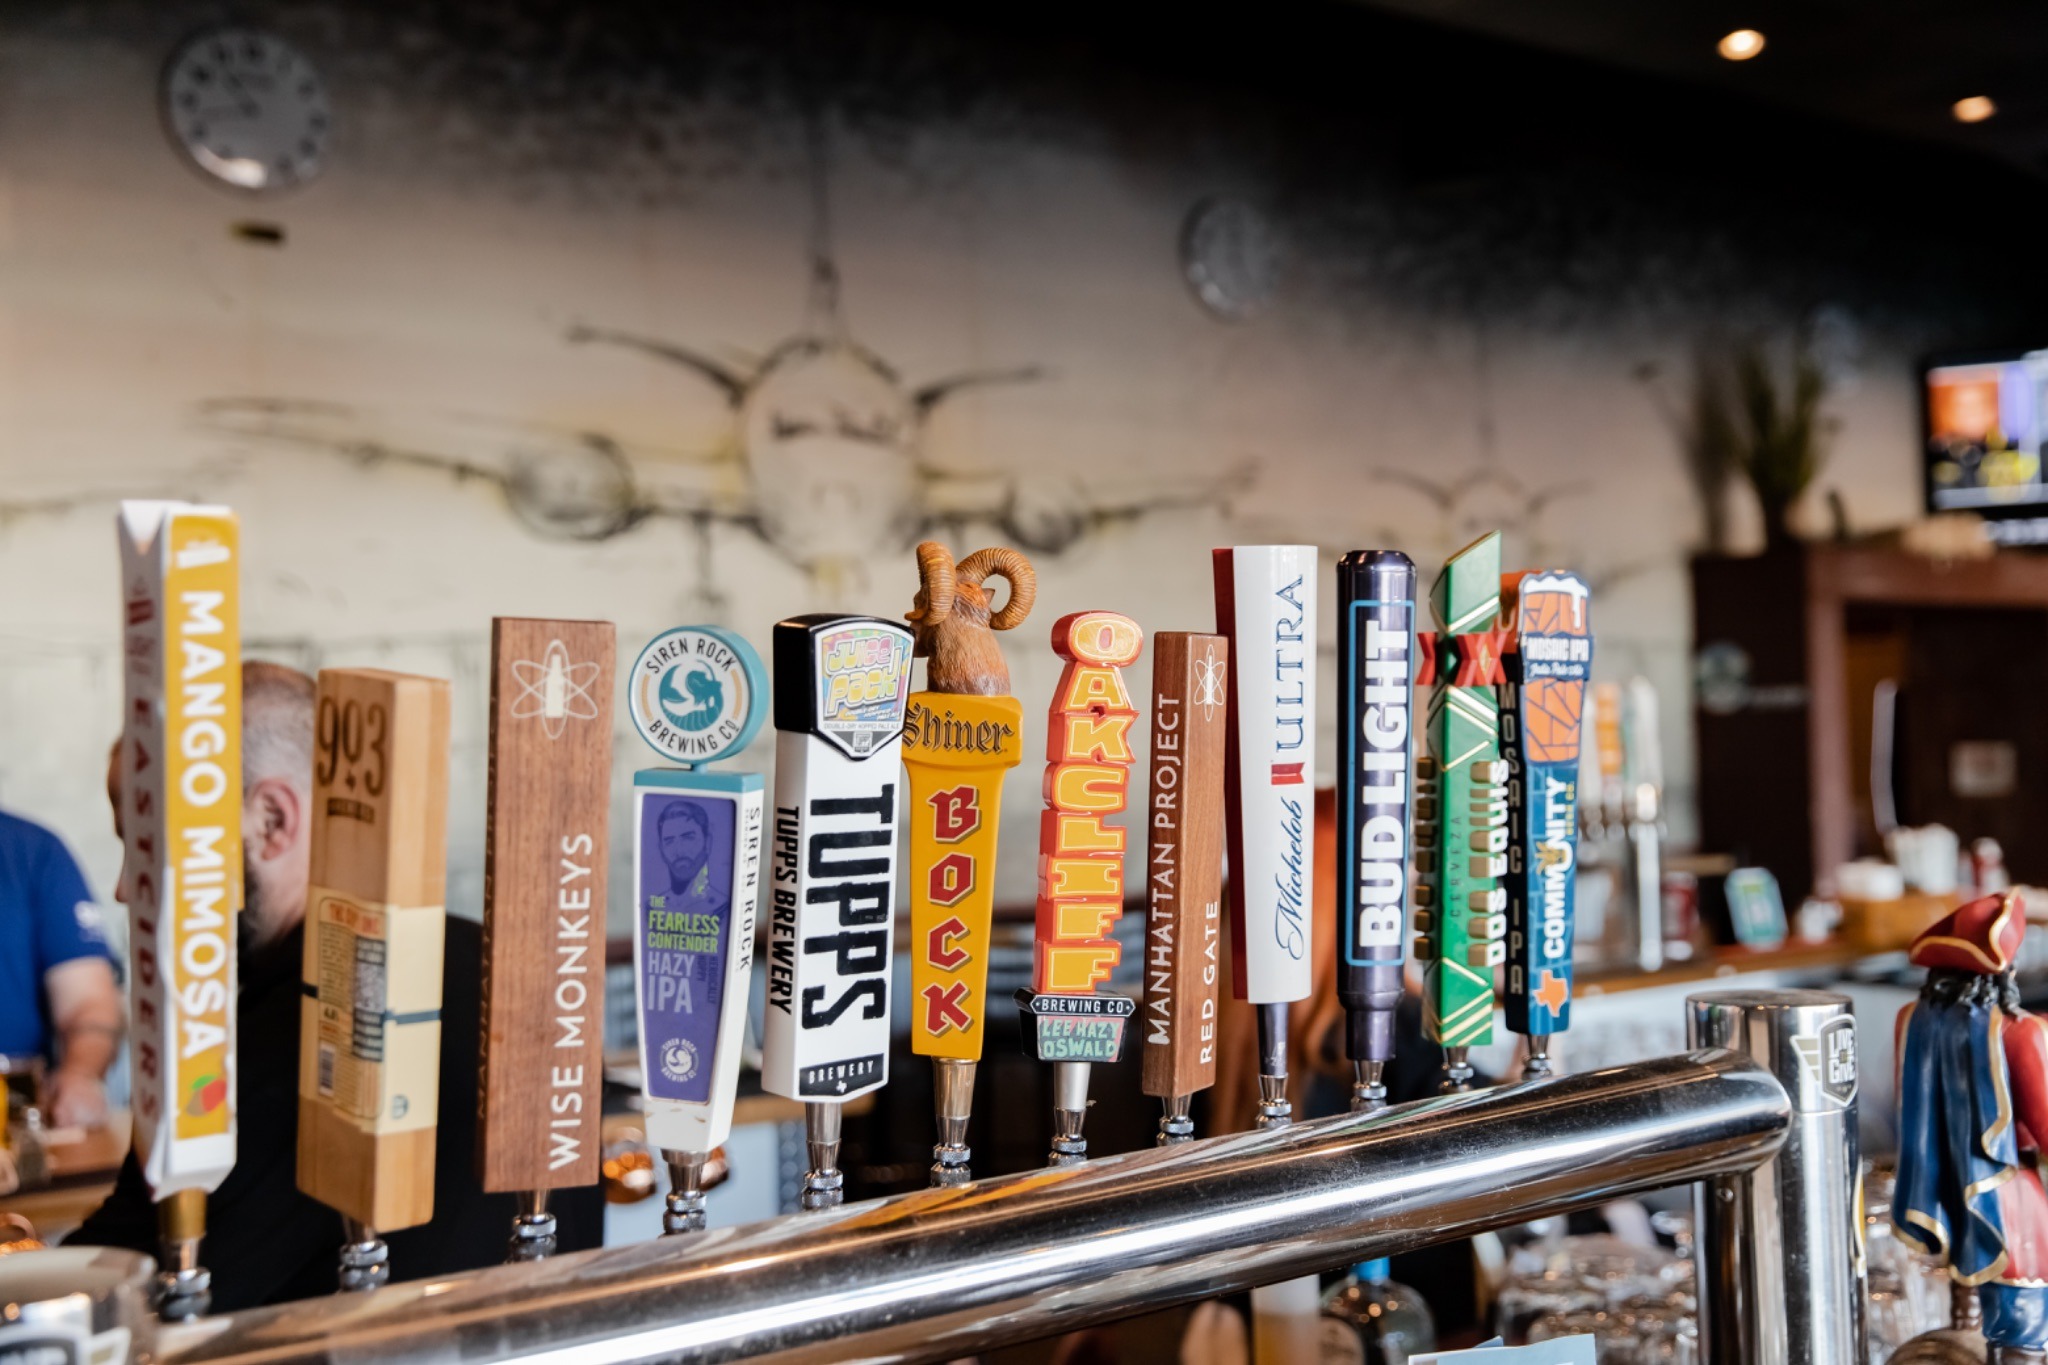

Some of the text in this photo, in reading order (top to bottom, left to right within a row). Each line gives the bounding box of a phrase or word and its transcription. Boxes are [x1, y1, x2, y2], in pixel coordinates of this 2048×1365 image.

[646, 638, 736, 674] SIREN ROCK
[1275, 574, 1304, 753] ULTRA
[316, 697, 387, 797] 903
[649, 720, 718, 754] BREWING
[902, 702, 1015, 755] Shiner
[180, 590, 227, 1060] MANGO MIMOSA
[1359, 619, 1409, 947] BUD LIGHT
[746, 806, 761, 888] SIREN
[1147, 693, 1180, 1046] MANHATTAN PROJECT
[1275, 796, 1304, 961] Michelob
[1450, 816, 1462, 918] CERVEZA
[1484, 759, 1510, 968] DOS EQUIS
[1500, 682, 1523, 995] MOSAIC IPA
[1543, 776, 1573, 959] COMMUNITY
[647, 931, 718, 954] CONTENDER
[648, 910, 720, 936] FEARLESS
[650, 895, 666, 908] THE
[740, 899, 755, 971] ROCK
[770, 805, 800, 1016] TUPPS BREWERY
[801, 783, 895, 1029] TUPPS
[921, 784, 981, 1036] BOCK
[548, 833, 593, 1172] WISE MONKEYS
[647, 951, 695, 977] HAZY
[647, 975, 693, 1014] IPA
[1041, 998, 1124, 1013] BREWING CO
[1199, 900, 1218, 1064] RED GATE
[809, 1060, 874, 1084] BREWERY
[1042, 1018, 1119, 1039] LEE HAZY
[1043, 1038, 1117, 1058] OSWALD
